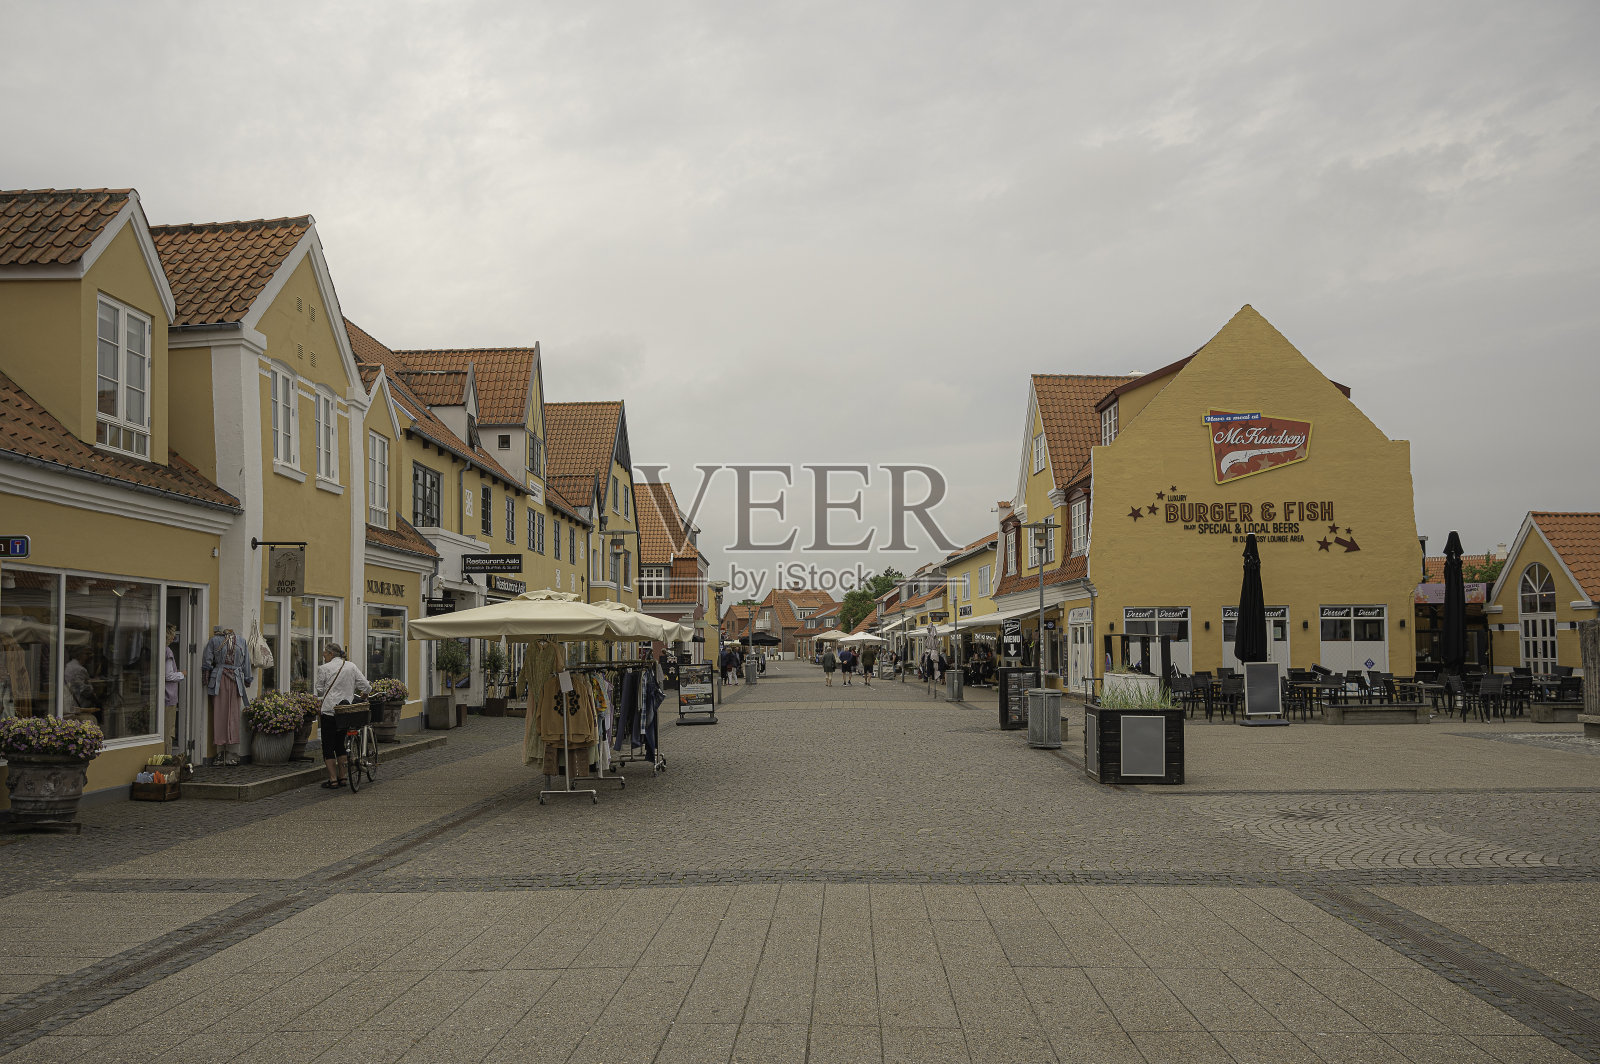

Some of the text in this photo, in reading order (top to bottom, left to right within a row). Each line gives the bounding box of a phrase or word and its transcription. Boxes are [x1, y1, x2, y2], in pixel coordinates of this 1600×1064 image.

[1167, 494, 1187, 502] LUXURY
[1165, 501, 1334, 523] BURGER & FISH
[1198, 522, 1233, 534] SPECIAL
[1234, 523, 1243, 534] &
[1244, 522, 1271, 534] LOCAL
[1272, 522, 1300, 534] BEERS
[1239, 535, 1248, 543] OU
[1256, 535, 1267, 543] OSY
[1267, 535, 1289, 543] LOUNGE
[1289, 534, 1305, 543] AREA
[466, 558, 505, 566] Restaurant
[276, 586, 297, 594] SHOP
[1003, 635, 1021, 643] MENU
